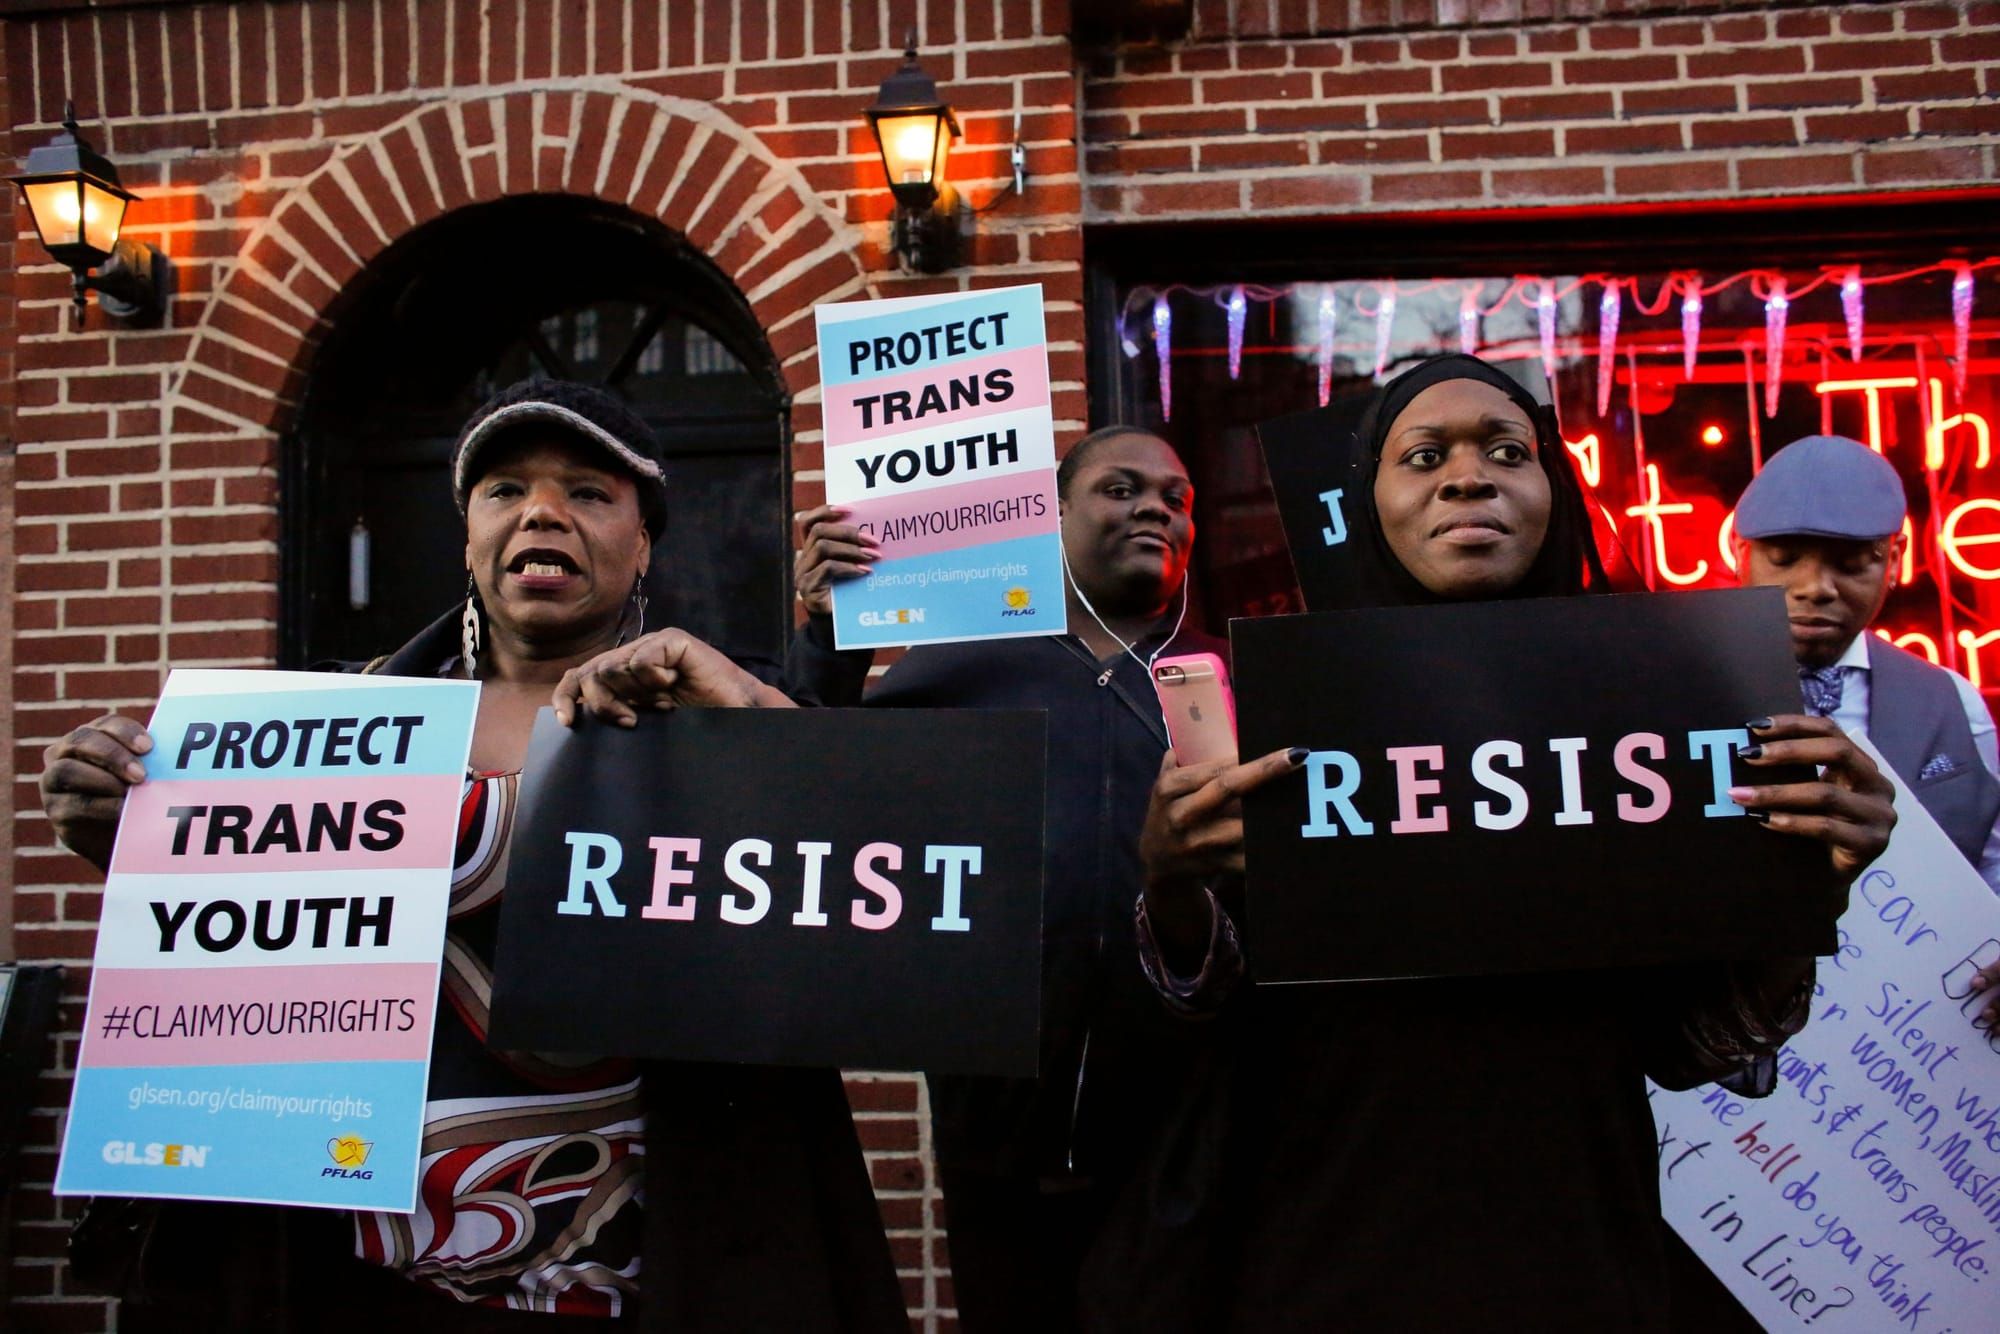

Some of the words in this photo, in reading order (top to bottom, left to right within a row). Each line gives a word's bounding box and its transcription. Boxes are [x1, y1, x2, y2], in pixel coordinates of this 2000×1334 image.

[849, 312, 1008, 376] PROTECT
[853, 368, 1014, 429] TRANS
[855, 429, 1019, 489] YOUTH
[866, 563, 1028, 592] glsen.org/claimyourrights
[858, 608, 925, 627] GLSEN
[1001, 608, 1036, 617] PFLAG
[175, 715, 425, 770] PROTECT
[1301, 728, 1750, 838] RESIST
[166, 798, 407, 857] TRANS
[557, 831, 982, 932] RESIST
[1861, 869, 1938, 946] ear
[149, 895, 394, 953] YOUTH
[102, 999, 416, 1040] #CLAIMYOURRIGHTS
[129, 1082, 372, 1122] glsen.org/claimyourrights
[1697, 1087, 1744, 1126] he
[102, 1141, 207, 1168] GLSEN
[321, 1167, 373, 1180] PFLAG
[1733, 1120, 1801, 1183] hell
[1826, 1104, 1864, 1135] &
[1851, 1120, 1918, 1203] trans
[1700, 1194, 1743, 1242] in
[1782, 1171, 1820, 1211] do
[1799, 1213, 1863, 1264] you
[1868, 1253, 1932, 1331] think
